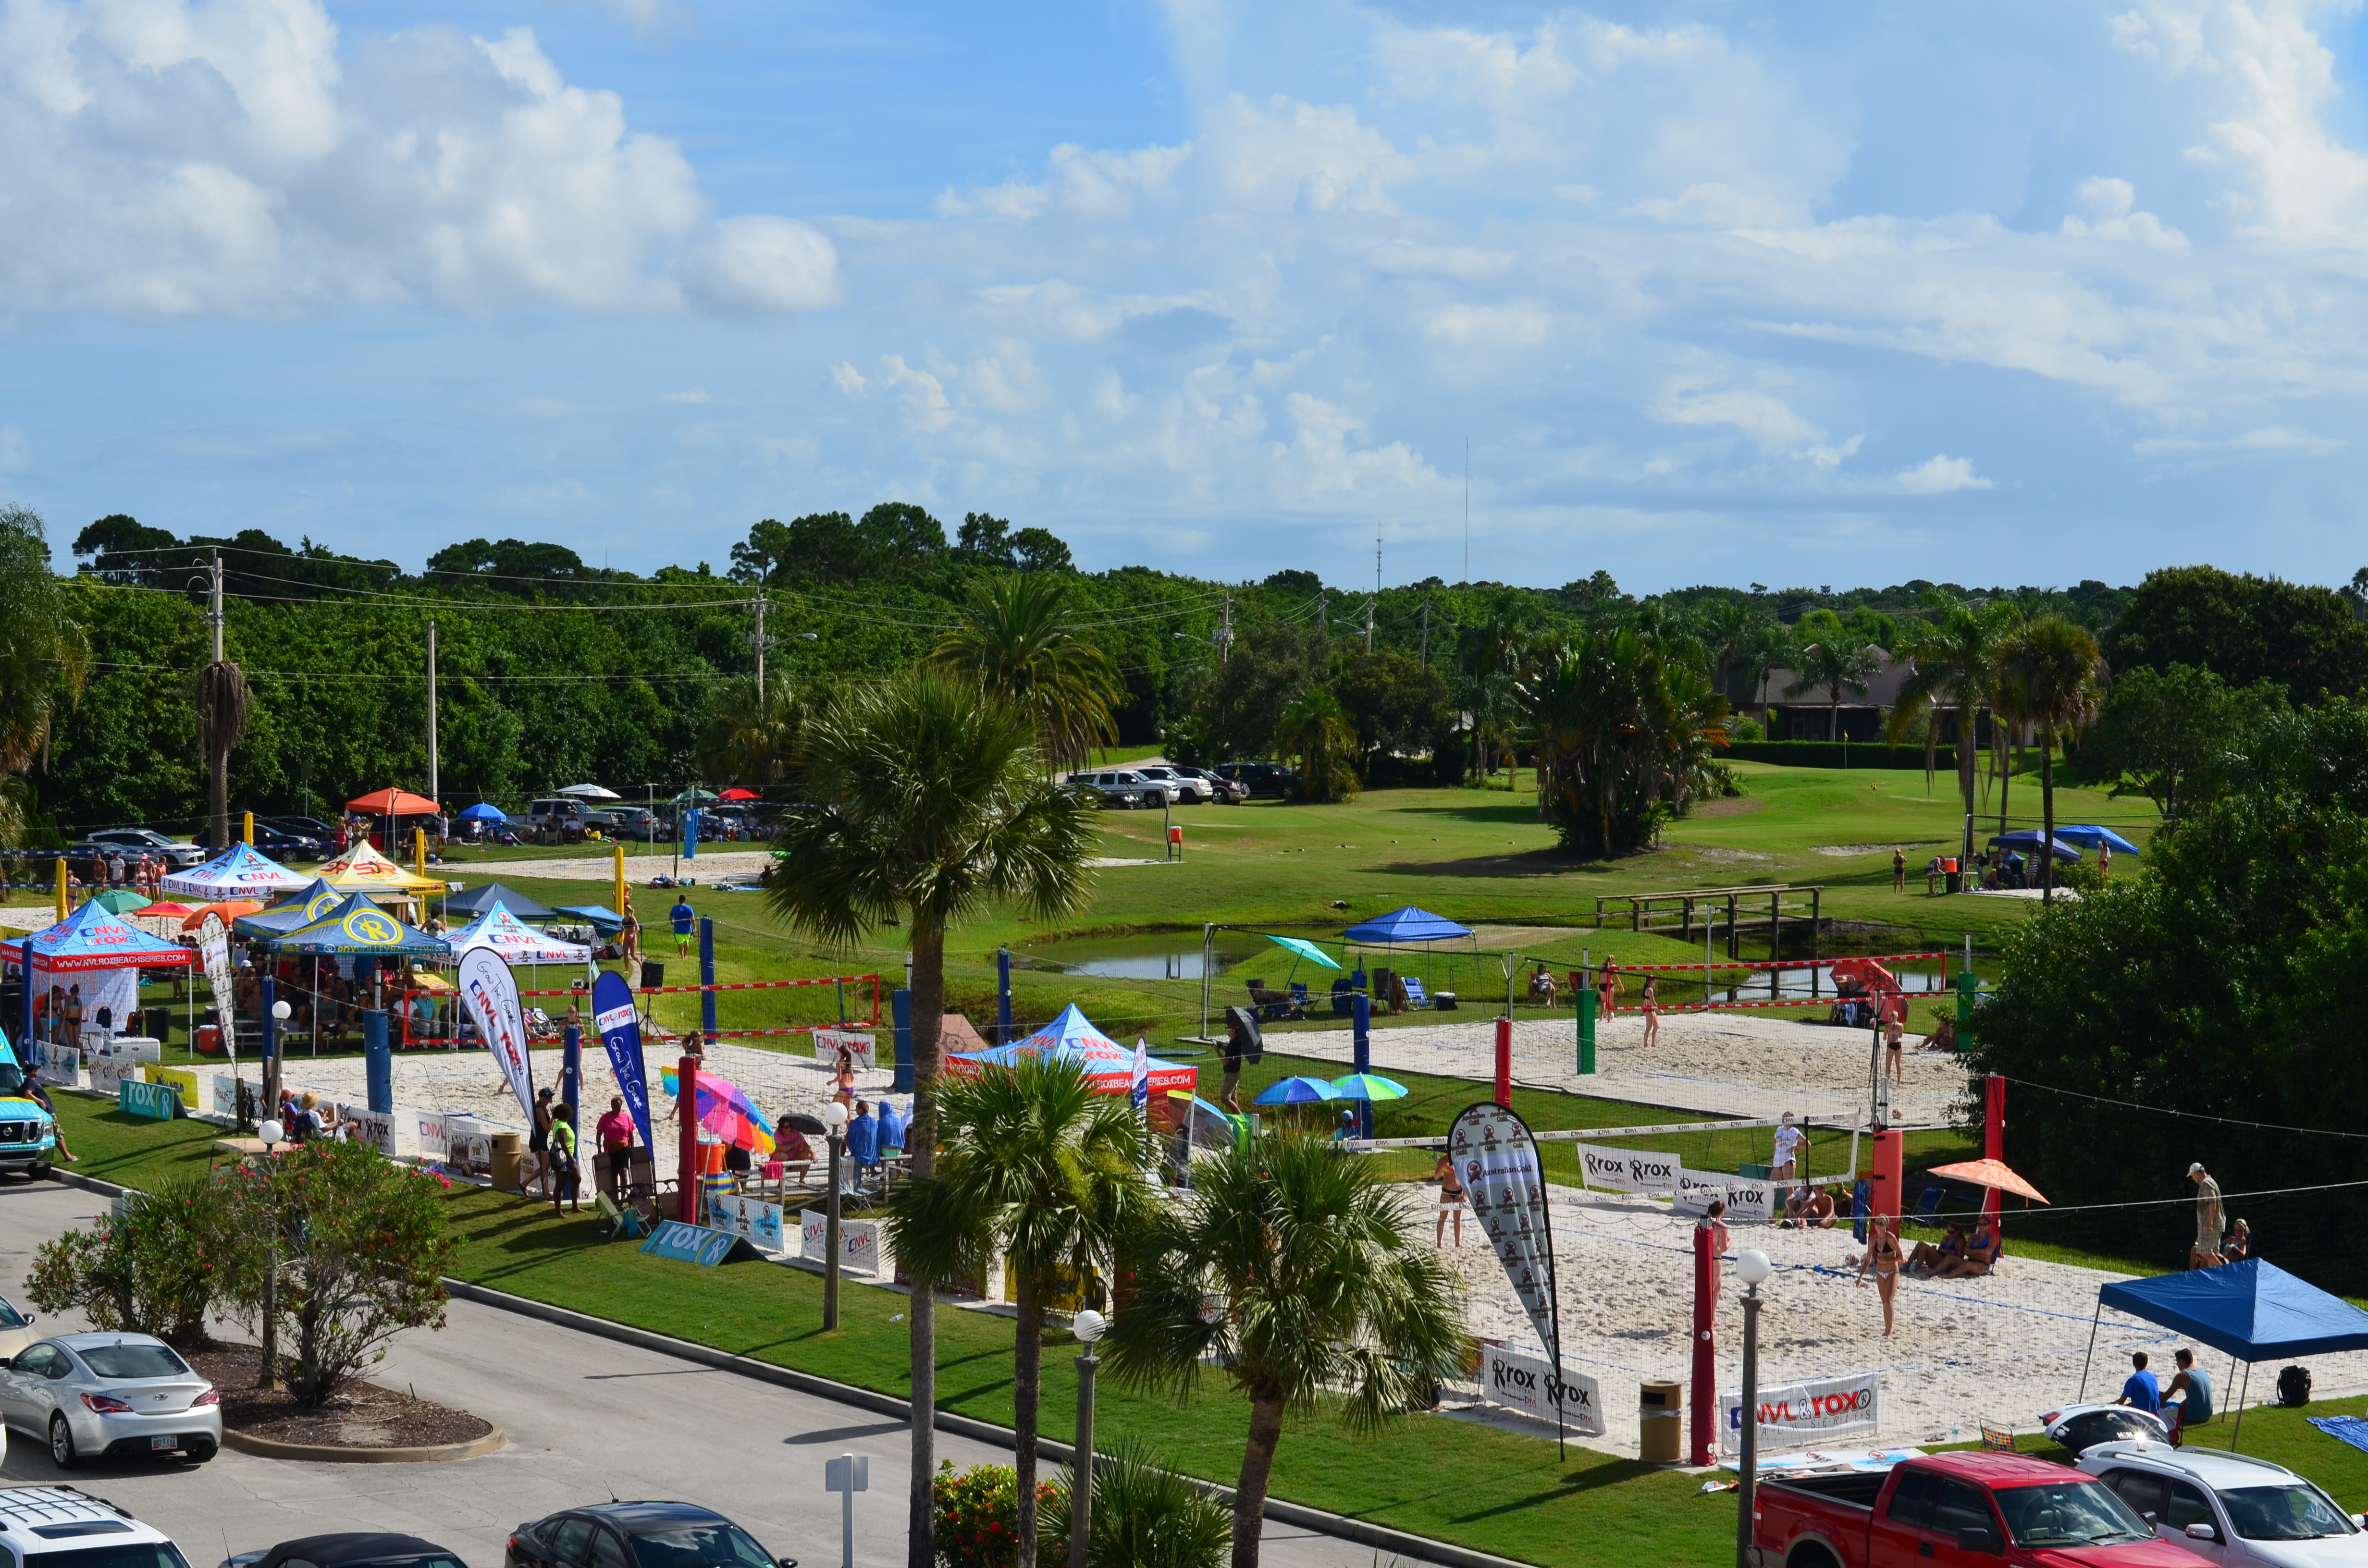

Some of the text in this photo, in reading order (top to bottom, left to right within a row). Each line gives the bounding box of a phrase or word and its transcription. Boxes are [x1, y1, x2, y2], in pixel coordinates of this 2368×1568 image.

[57, 954, 185, 968] WWW.NVLROXBEACHSERIES.COM
[477, 961, 516, 1025] Grow The Game
[611, 1036, 623, 1063] Grow
[620, 1051, 634, 1080] The
[128, 1083, 156, 1107] rox
[626, 1080, 642, 1109] Game
[659, 1225, 711, 1251] rox
[1506, 1383, 1536, 1396] VOLLEYBALL
